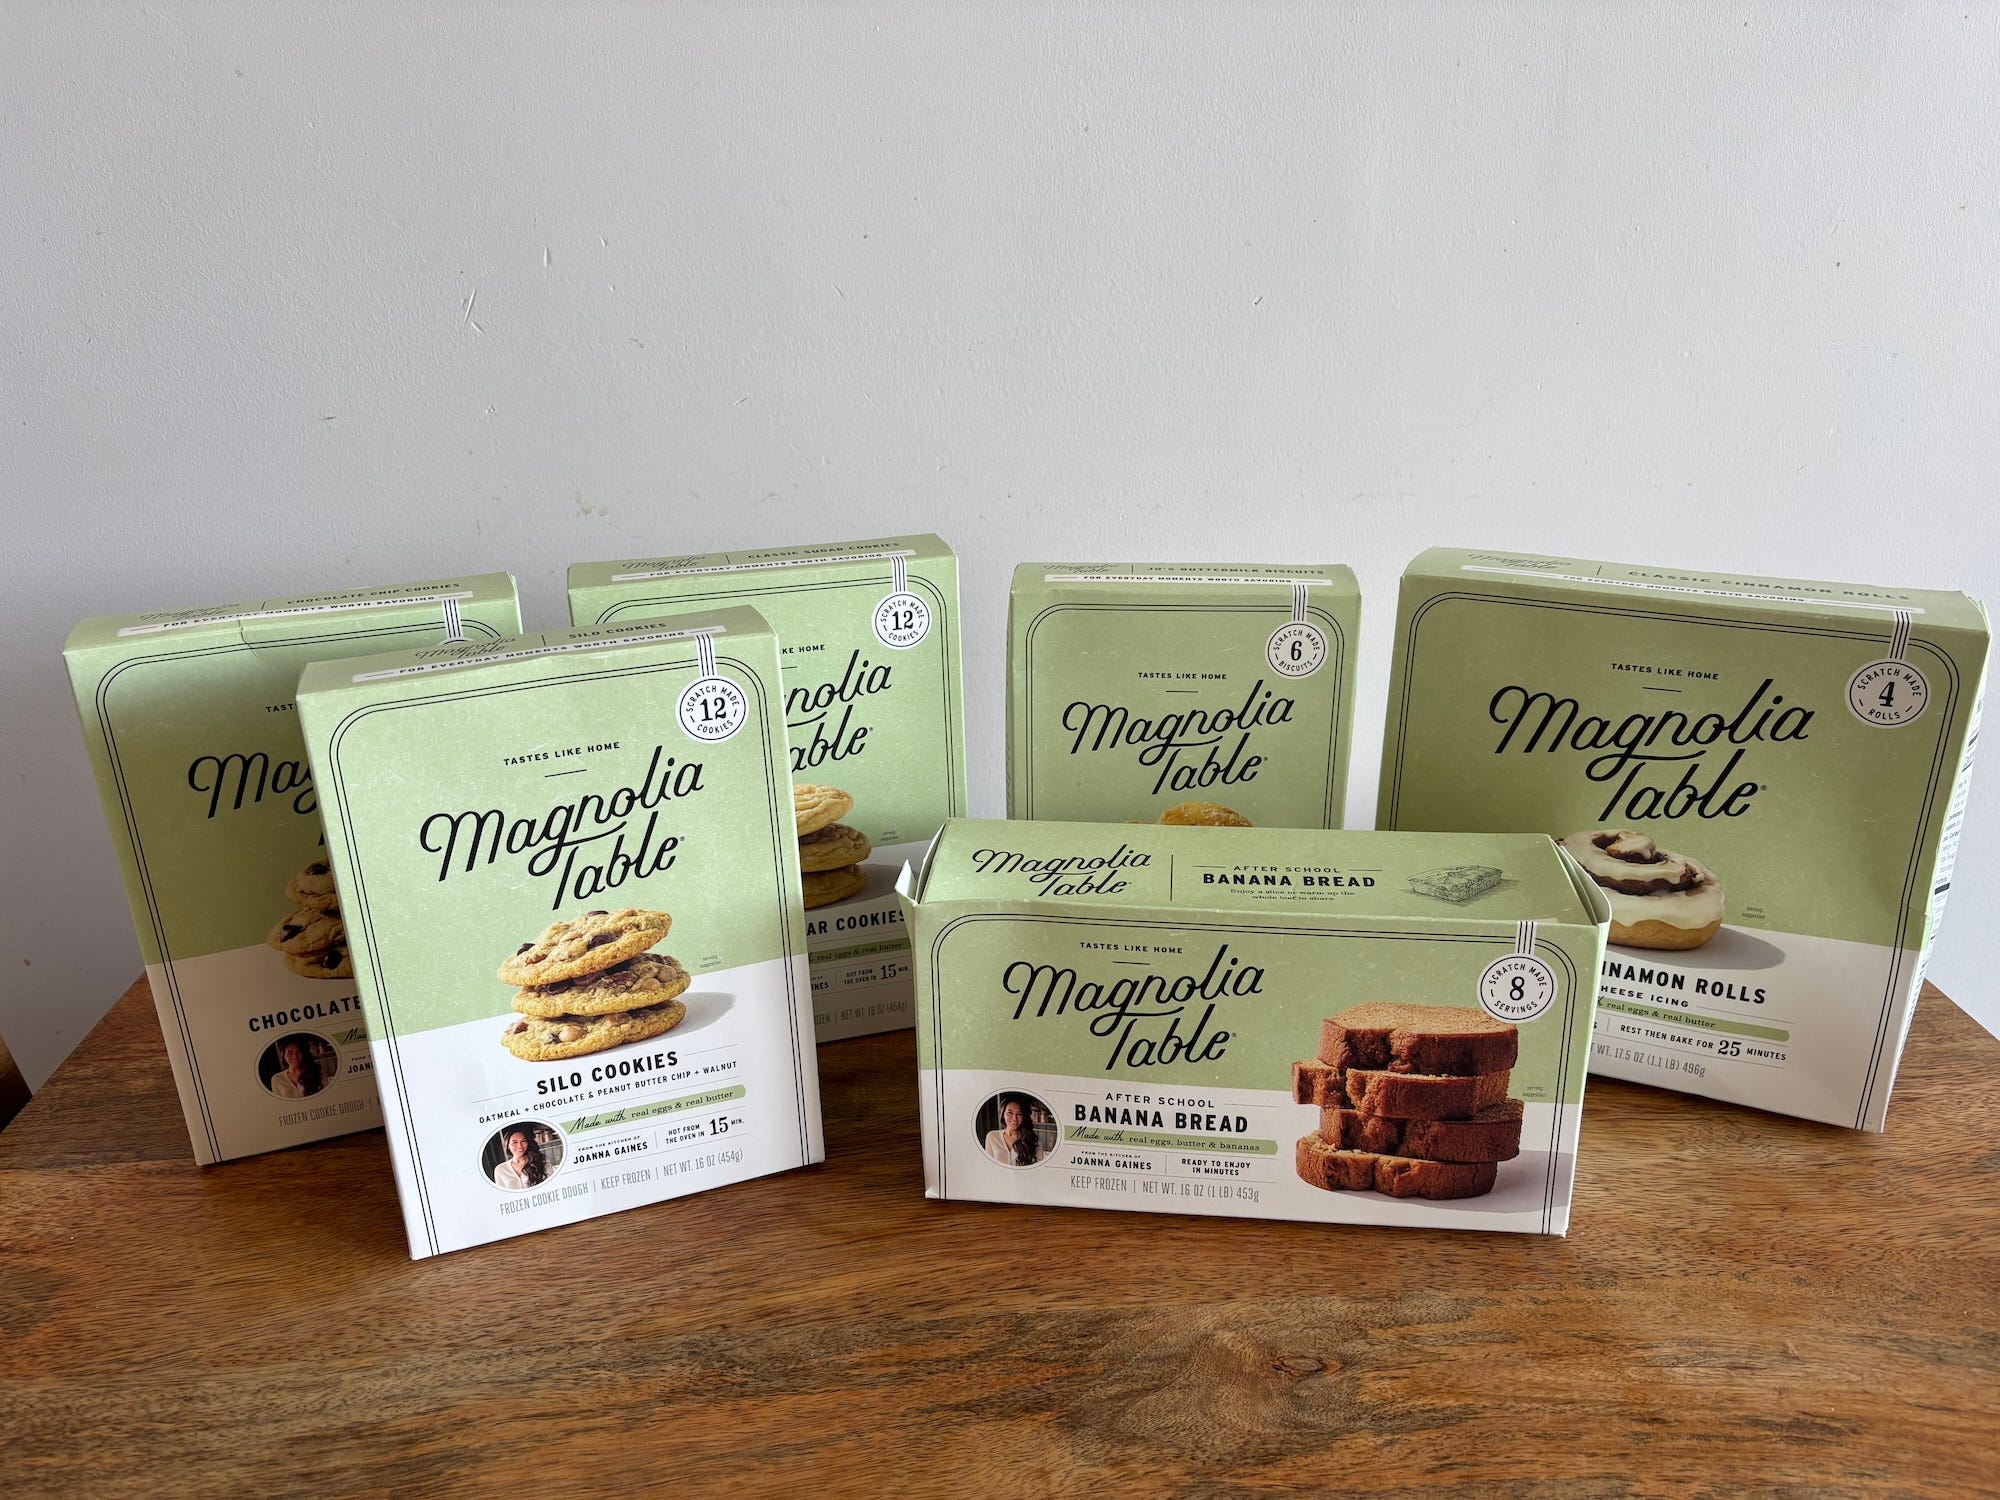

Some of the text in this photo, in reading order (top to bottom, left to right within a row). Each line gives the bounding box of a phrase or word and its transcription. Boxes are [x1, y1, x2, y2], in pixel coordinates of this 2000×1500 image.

[748, 542, 900, 559] CLASSIC SUGAR COOKIES
[288, 583, 460, 605] CHOCOLATE CHIP COOKIES
[1628, 571, 1910, 600] CLASSIC CINNAMON ROLLS
[880, 599, 925, 622] SCRATCH MADE
[891, 610, 914, 631] 12
[569, 623, 667, 639] SILO COOKIES
[888, 630, 919, 642] COOKIES
[1273, 629, 1321, 651] SCRATCH MADE
[400, 631, 685, 674] FOR EVERYDAY MOMENTS WORTH SAVORING
[798, 644, 826, 653] HOME
[1290, 640, 1303, 661] 6
[1138, 671, 1228, 681] TASTES LIKE HOME
[1278, 659, 1314, 672] BISCUITS
[1612, 663, 1719, 681] TASTES LIKE HOME
[784, 649, 892, 728] nolia
[1858, 668, 1922, 696] SCRATCH MADE
[686, 685, 740, 712] SCRATCH MADE
[1878, 681, 1895, 708] 4
[700, 697, 727, 722] 12
[1868, 708, 1901, 720] ROLLS
[697, 719, 734, 734] COOKIES
[1062, 679, 1295, 766] Magnolia
[1489, 678, 1815, 782] Magnolia
[789, 704, 869, 774] able
[503, 741, 620, 766] TASTES LIKE HOME
[420, 745, 704, 882] Magnolia
[972, 843, 1152, 883] Magnolia
[1233, 865, 1278, 873] AFTER
[1037, 869, 1129, 897] Table
[1203, 873, 1375, 887] BANANA BREAD
[836, 910, 904, 931] COOKIES
[1080, 942, 1183, 954] TASTES LIKE HOME
[880, 964, 897, 980] 15
[1489, 963, 1547, 987] SCRATCH MADE
[1003, 944, 1265, 1036] Magnolia
[1509, 976, 1525, 1001] 8
[1600, 985, 1689, 1008] HEESE ICING
[1695, 978, 1767, 1005] ROLLS
[249, 995, 361, 1032] CHOCOLATE
[1494, 1000, 1538, 1013] SERVINGS
[1606, 1002, 1716, 1029] real eggs real butter
[1620, 1024, 1786, 1061] REST THEN BAKE FOR 25 MINUTES
[347, 1061, 374, 1074] JOAN
[1597, 1043, 1706, 1078] WT. 17.5 OZ (1.1 LB) 496g
[536, 1051, 678, 1095] SILO COOKIES
[479, 1060, 737, 1124] OATMEAL CHOCOLATE PEANUT BUTTER CHIP WALNUT
[1106, 1092, 1215, 1108] AFTER SCHOOL
[569, 1091, 734, 1134] Made with real eggs real butter
[1075, 1104, 1248, 1133] BANANA BREAD
[665, 1130, 705, 1145] THE OVEN IN
[668, 1124, 700, 1136] HOT FROM
[709, 1116, 729, 1136] 15
[1070, 1126, 1101, 1140] Made
[1104, 1130, 1124, 1142] with
[1129, 1136, 1147, 1144] real
[1176, 1139, 1206, 1148] butter
[1220, 1142, 1260, 1151] bananas
[573, 1141, 648, 1165] JOANNA GAINES
[1070, 1156, 1152, 1170] JOANNA GAINES
[1181, 1158, 1207, 1167] READY
[1224, 1160, 1251, 1169] ENJOY
[500, 1197, 530, 1216] FROZEN
[532, 1190, 560, 1208] COOKIE
[561, 1182, 589, 1200] DOUGH
[600, 1175, 623, 1190] KEEP
[622, 1169, 651, 1185] FROZEN
[663, 1162, 678, 1177] NET
[695, 1157, 704, 1170] 16
[706, 1154, 716, 1167] OZ
[717, 1148, 743, 1165] (454g)
[1204, 1167, 1240, 1176] MINUTES
[1070, 1175, 1092, 1189] KEEP
[1095, 1177, 1127, 1191] FROZEN
[1142, 1181, 1159, 1194] NET
[1180, 1183, 1190, 1196] 16
[1193, 1184, 1204, 1197] OZ
[1207, 1184, 1216, 1198] (1
[1219, 1186, 1233, 1199] LB)
[1236, 1187, 1260, 1203] 453g
